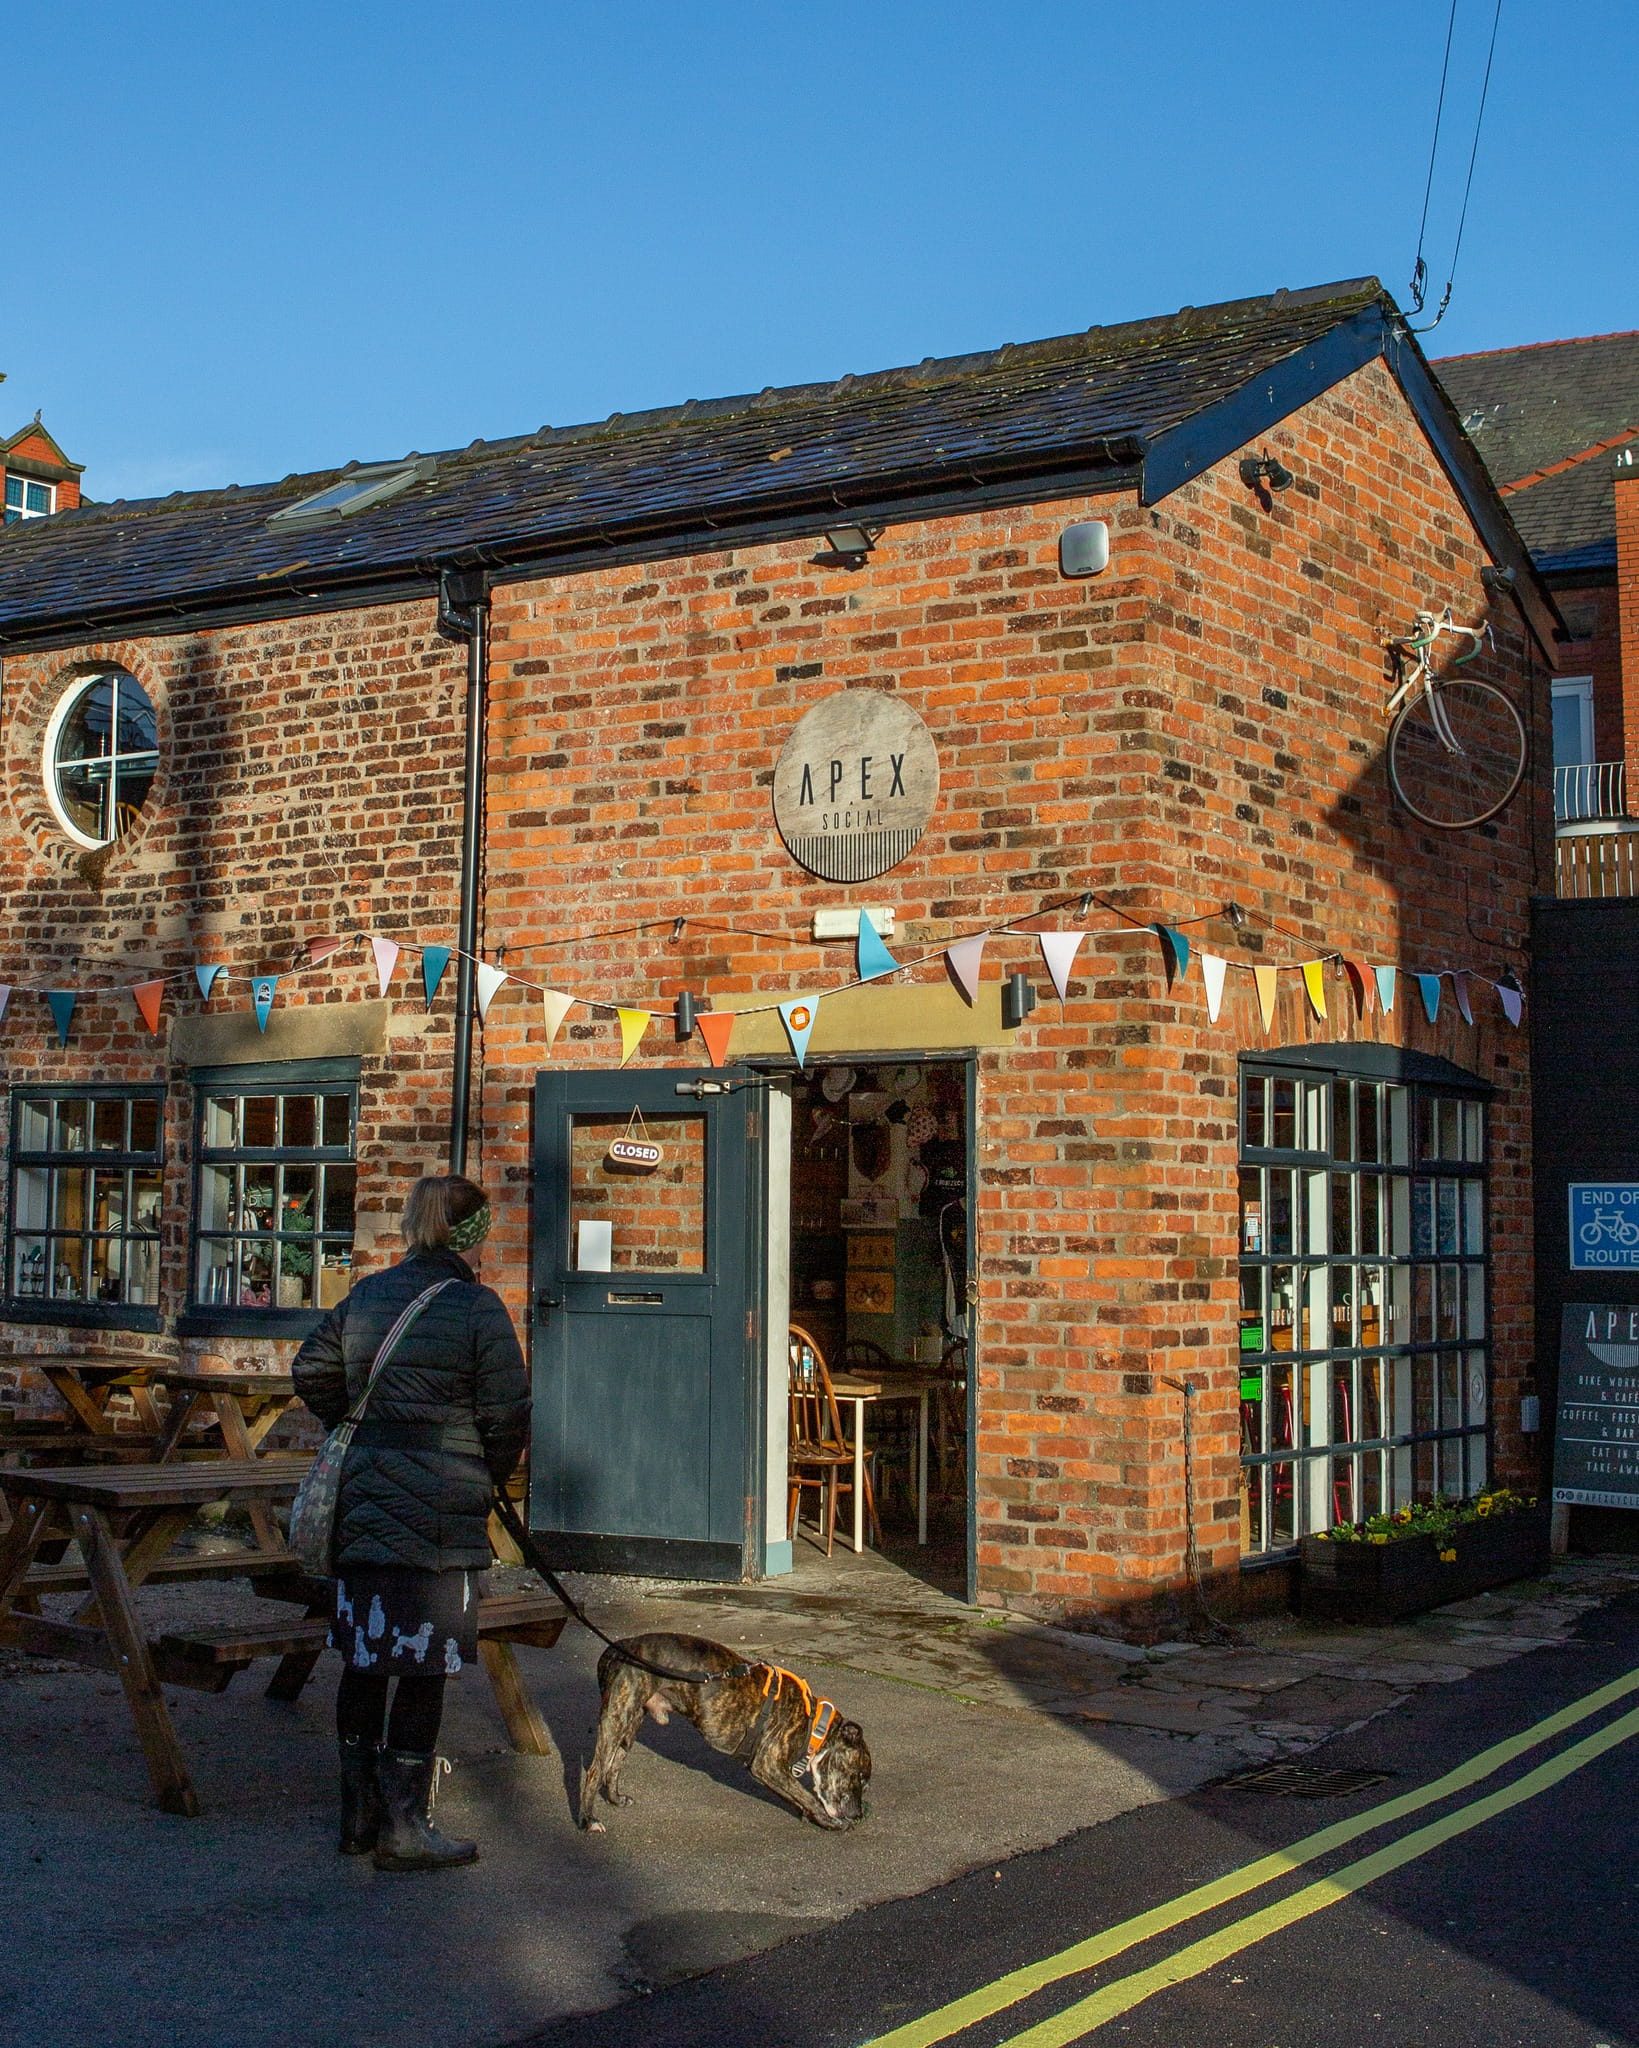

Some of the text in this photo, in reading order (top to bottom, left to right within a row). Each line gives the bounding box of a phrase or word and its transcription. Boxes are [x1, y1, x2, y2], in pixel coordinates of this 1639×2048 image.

[800, 754, 905, 806] APEX
[822, 809, 883, 831] SOCIAL
[613, 1144, 658, 1160] CLOSED
[1582, 1191, 1615, 1205] END
[1585, 1249, 1639, 1263] ROUTE
[1579, 1375, 1601, 1386] BIKE
[1601, 1391, 1607, 1401] &
[1612, 1412, 1639, 1424] FRES
[1602, 1427, 1634, 1438] & BAR
[1592, 1446, 1610, 1457] EAT
[1617, 1448, 1628, 1459] IN
